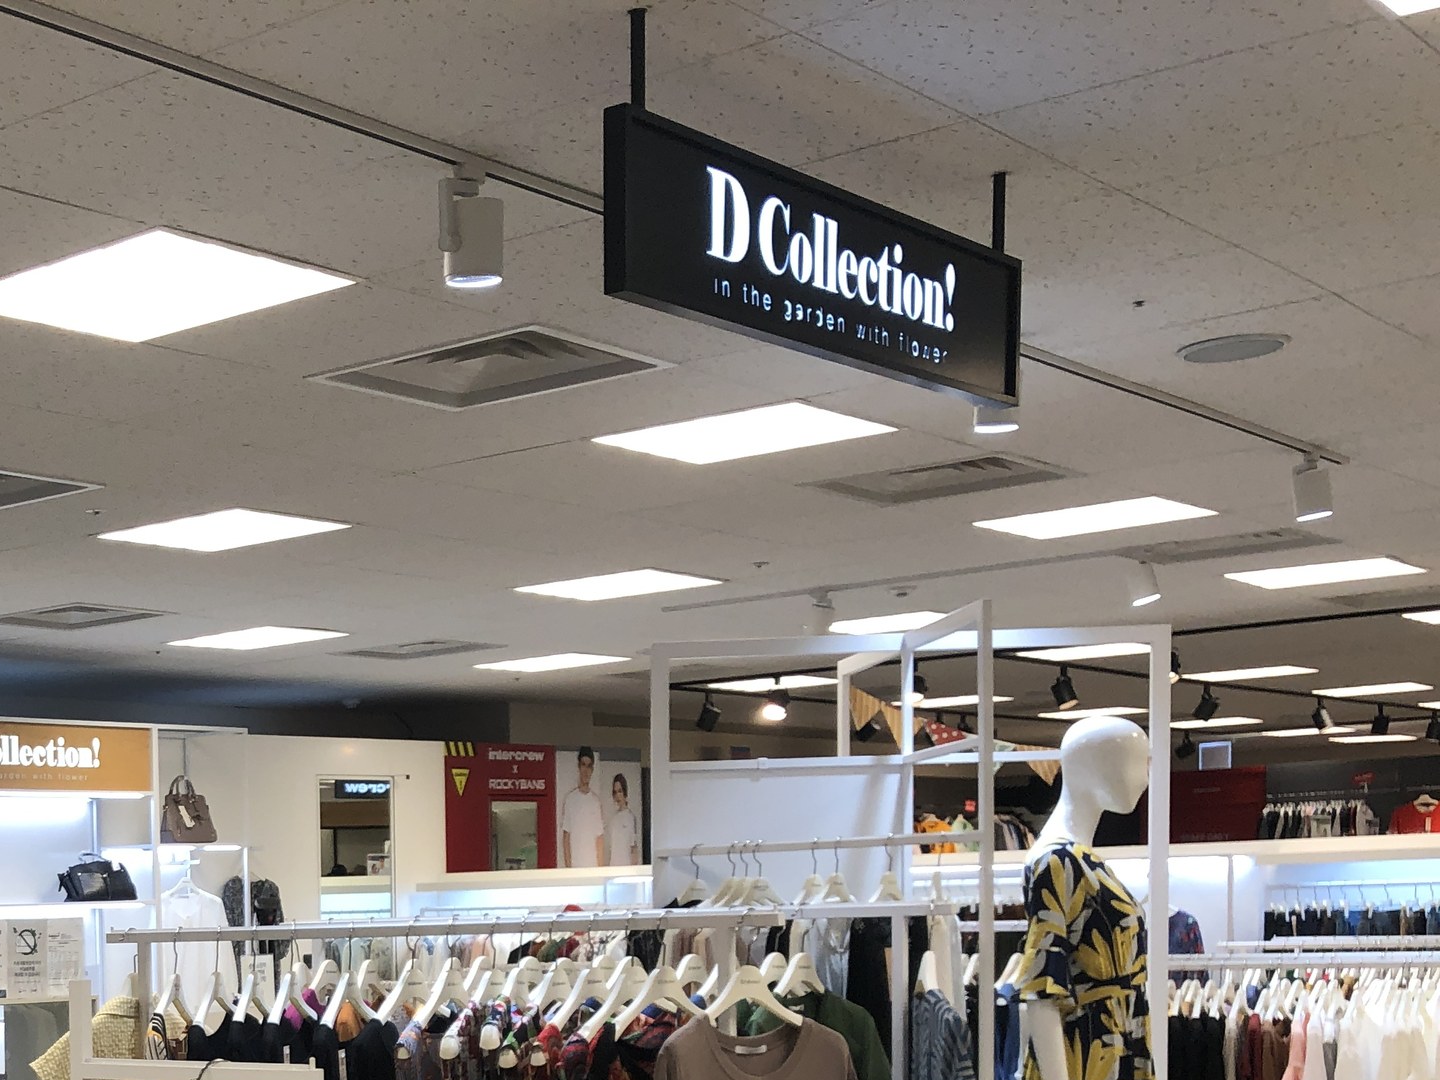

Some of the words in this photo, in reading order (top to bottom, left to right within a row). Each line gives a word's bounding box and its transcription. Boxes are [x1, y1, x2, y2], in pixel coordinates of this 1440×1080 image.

[706, 165, 750, 263] D
[758, 195, 957, 332] Collection!
[742, 283, 772, 311] the
[784, 299, 845, 333] garden
[856, 323, 889, 347] with
